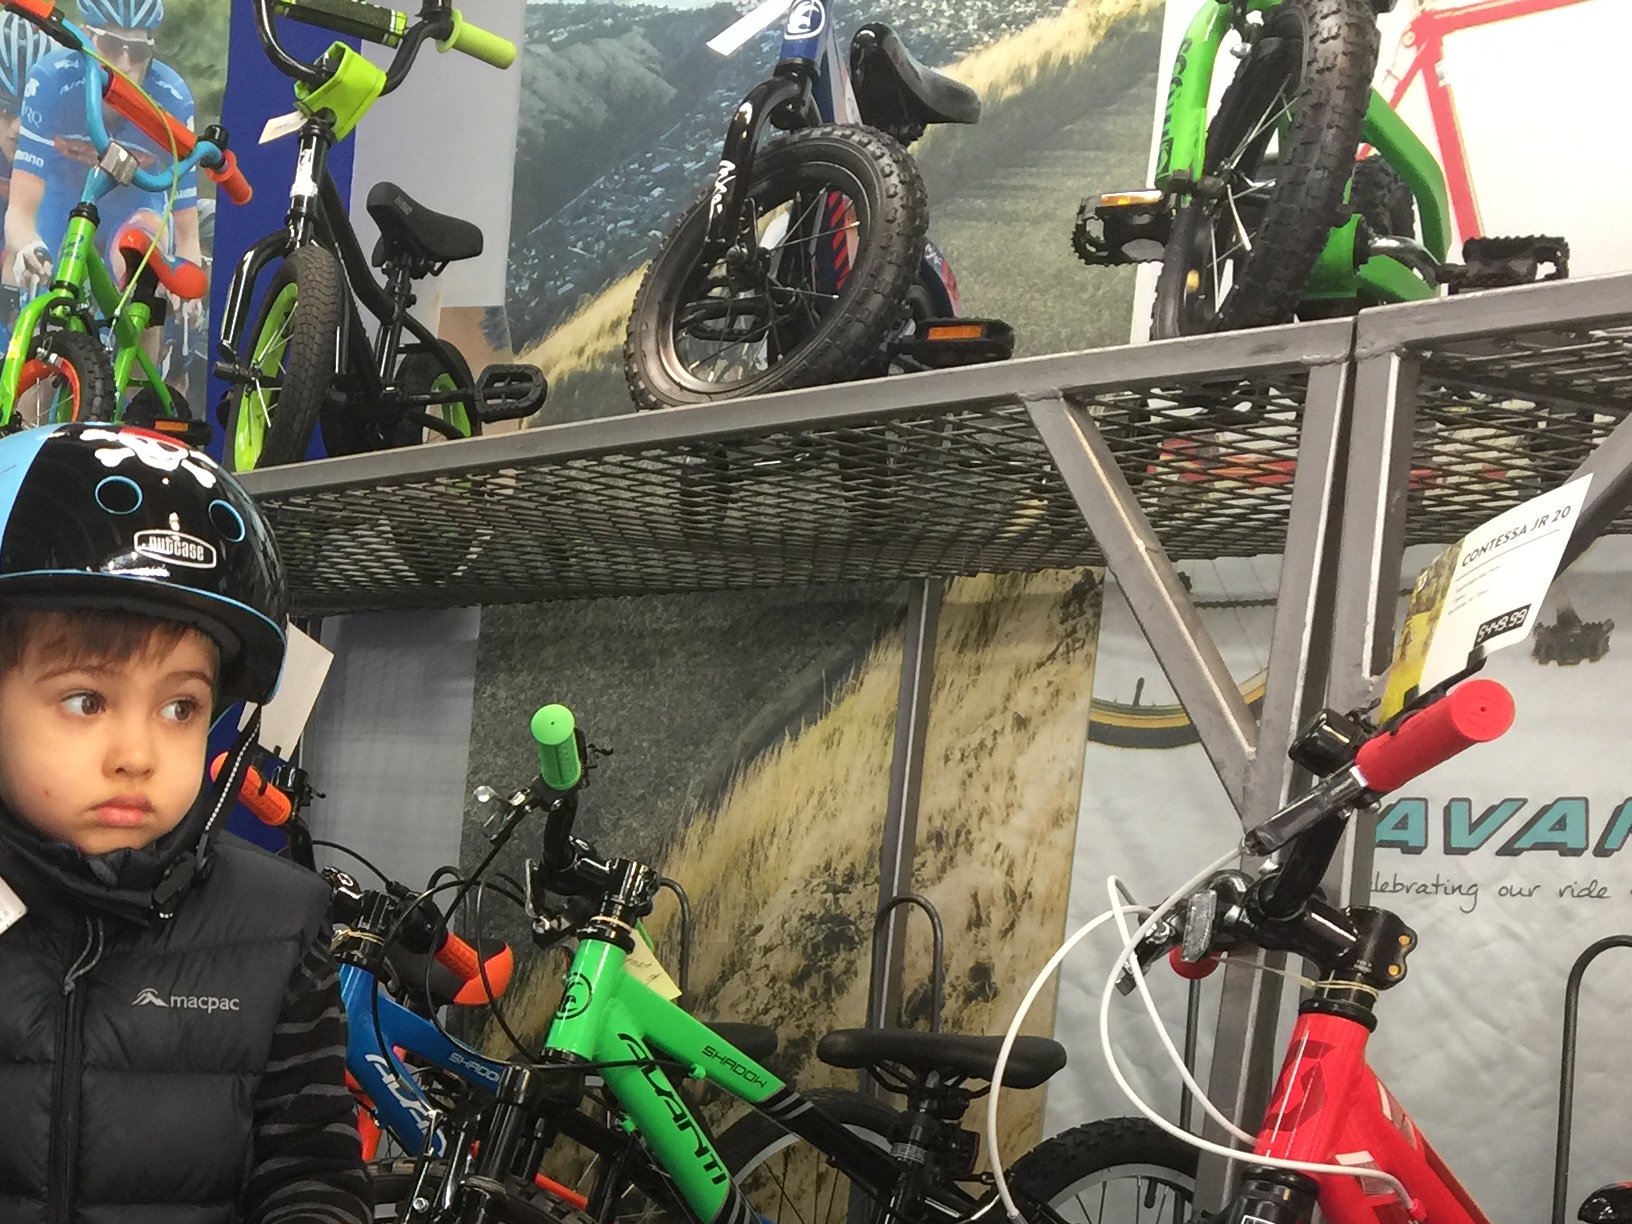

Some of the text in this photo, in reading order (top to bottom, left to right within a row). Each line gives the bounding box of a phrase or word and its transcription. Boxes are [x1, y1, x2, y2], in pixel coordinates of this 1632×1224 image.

[148, 534, 205, 562] nutcase
[1462, 504, 1573, 568] CONTESSA JR 20
[1476, 607, 1530, 644] $449.99
[1498, 882, 1541, 898] our
[1558, 879, 1612, 900] ride
[170, 995, 240, 1014] macpac
[448, 1052, 501, 1083] SHADO
[701, 1045, 768, 1089] SHADOW
[617, 1032, 729, 1187] AVANTI
